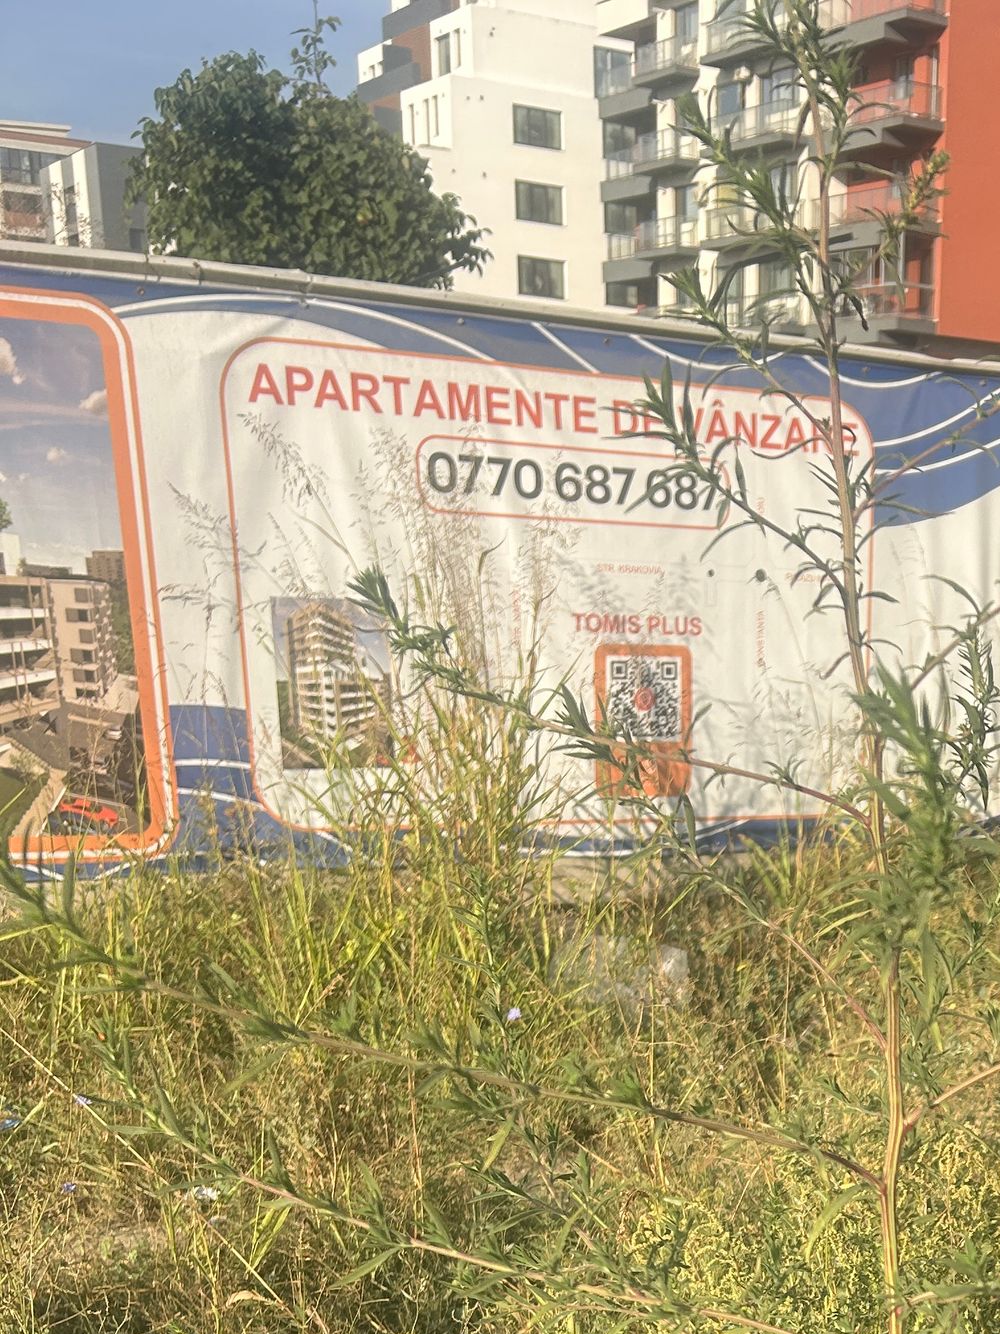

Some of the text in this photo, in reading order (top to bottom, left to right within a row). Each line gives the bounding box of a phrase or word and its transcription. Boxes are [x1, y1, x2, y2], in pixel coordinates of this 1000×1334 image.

[250, 364, 598, 434] APARTAMENTE
[426, 452, 543, 500] 0770
[554, 460, 637, 505] 687
[571, 612, 703, 637] TOMIS PLUS
